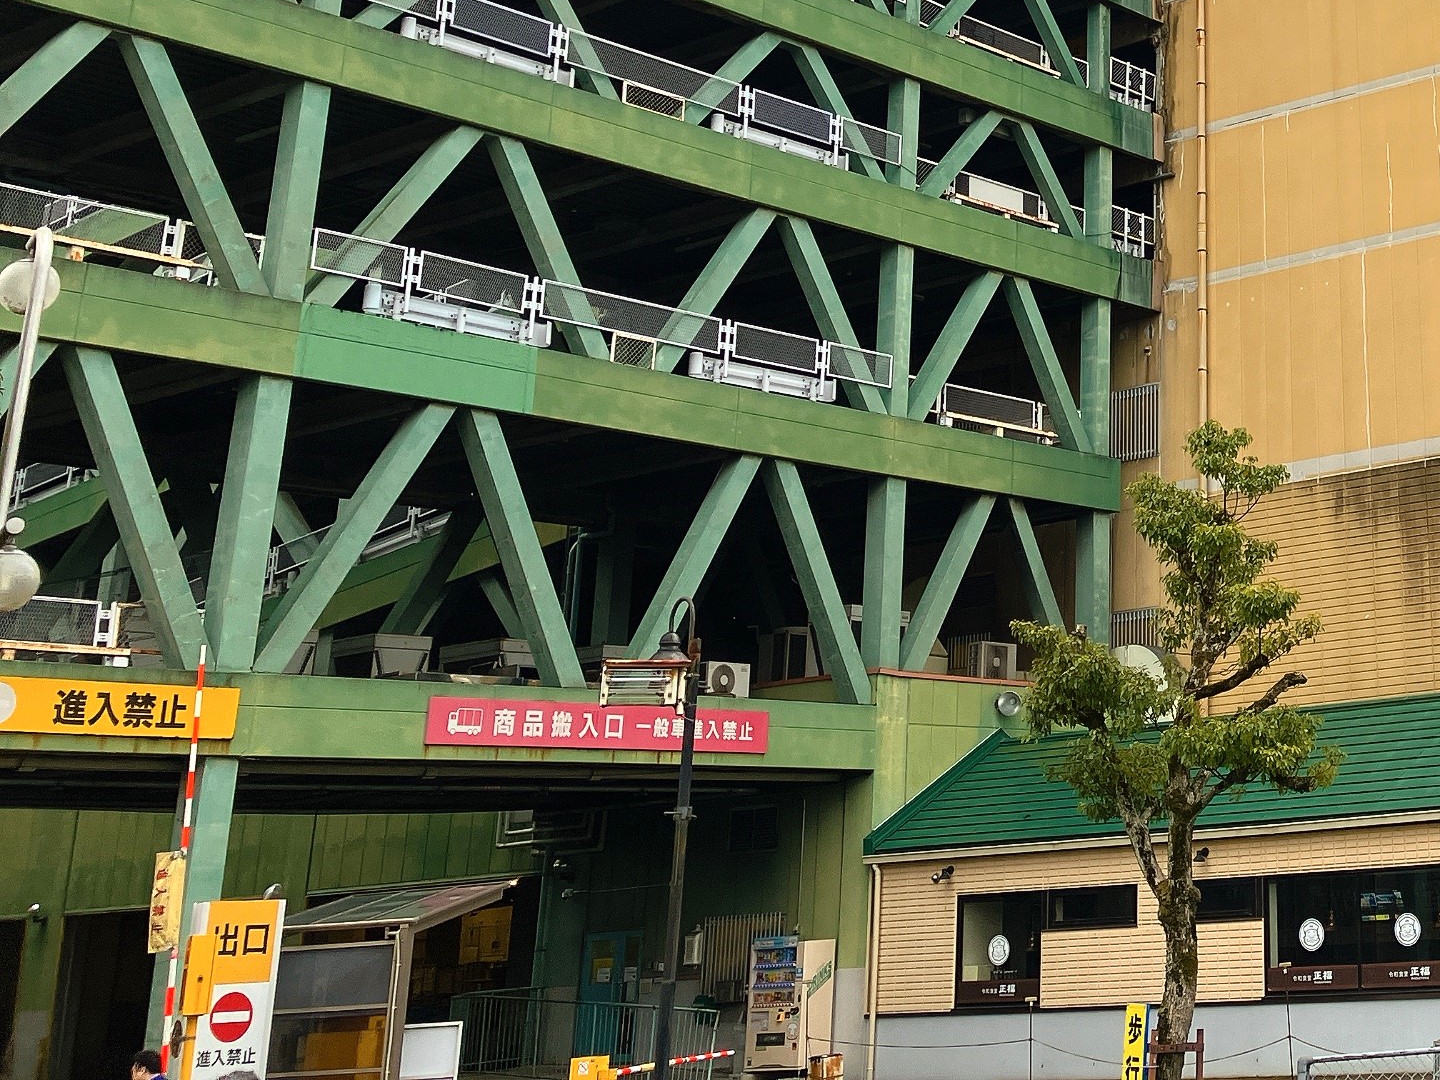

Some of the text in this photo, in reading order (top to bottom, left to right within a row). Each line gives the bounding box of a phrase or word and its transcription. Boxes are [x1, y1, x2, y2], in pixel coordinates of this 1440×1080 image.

[52, 689, 187, 729] 進入禁止
[493, 708, 624, 739] 商品搬入口
[214, 923, 271, 957] 出口
[196, 1046, 256, 1069] 進入禁止
